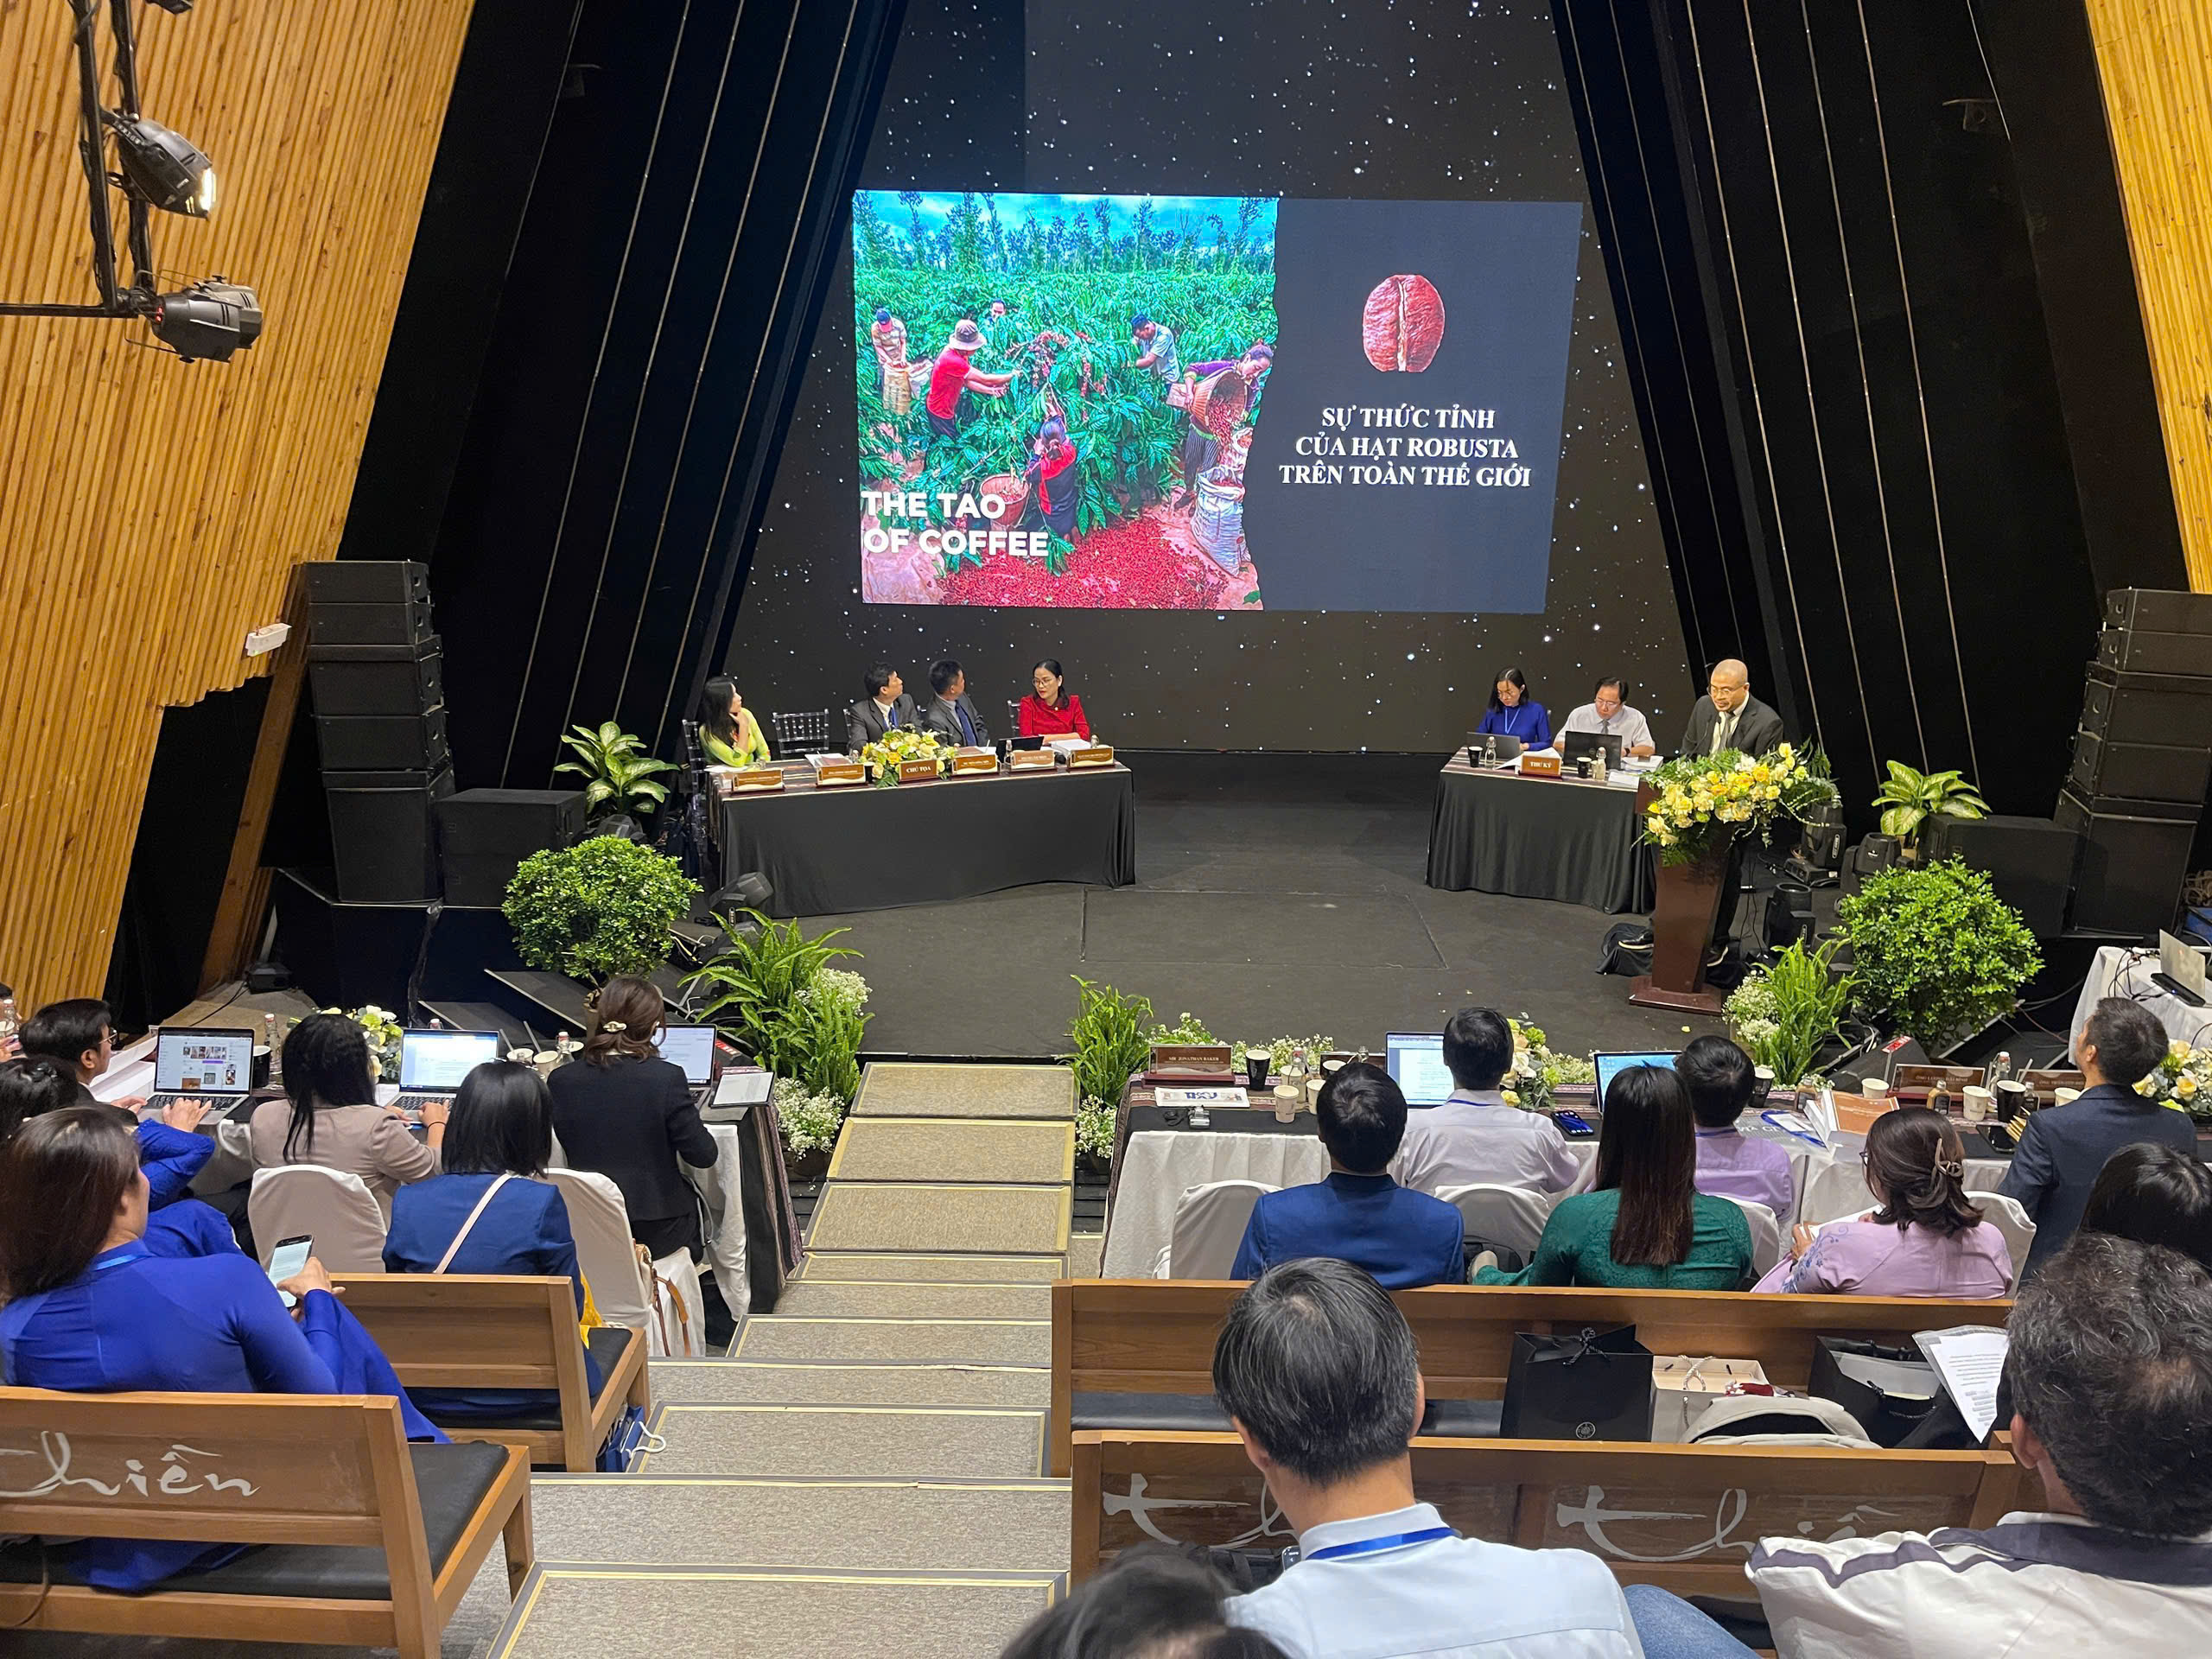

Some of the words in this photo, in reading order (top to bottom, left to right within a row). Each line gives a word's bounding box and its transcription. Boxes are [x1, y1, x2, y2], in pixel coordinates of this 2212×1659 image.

[1321, 404, 1357, 432] SỰ
[1360, 403, 1430, 429] THỨC
[1435, 404, 1496, 429] TỈNH
[1295, 432, 1346, 456] CỦA
[1351, 437, 1402, 461] HẠT
[1408, 438, 1519, 459] ROBUSTA
[1279, 459, 1344, 485] TRÊN
[1349, 461, 1416, 486] TOÀN
[1421, 462, 1471, 486] THẾ
[1476, 463, 1531, 487] GIỚI
[861, 491, 928, 518] THE
[936, 493, 1006, 519] TAO
[863, 528, 910, 554] OF
[918, 530, 1049, 557] COFFEE
